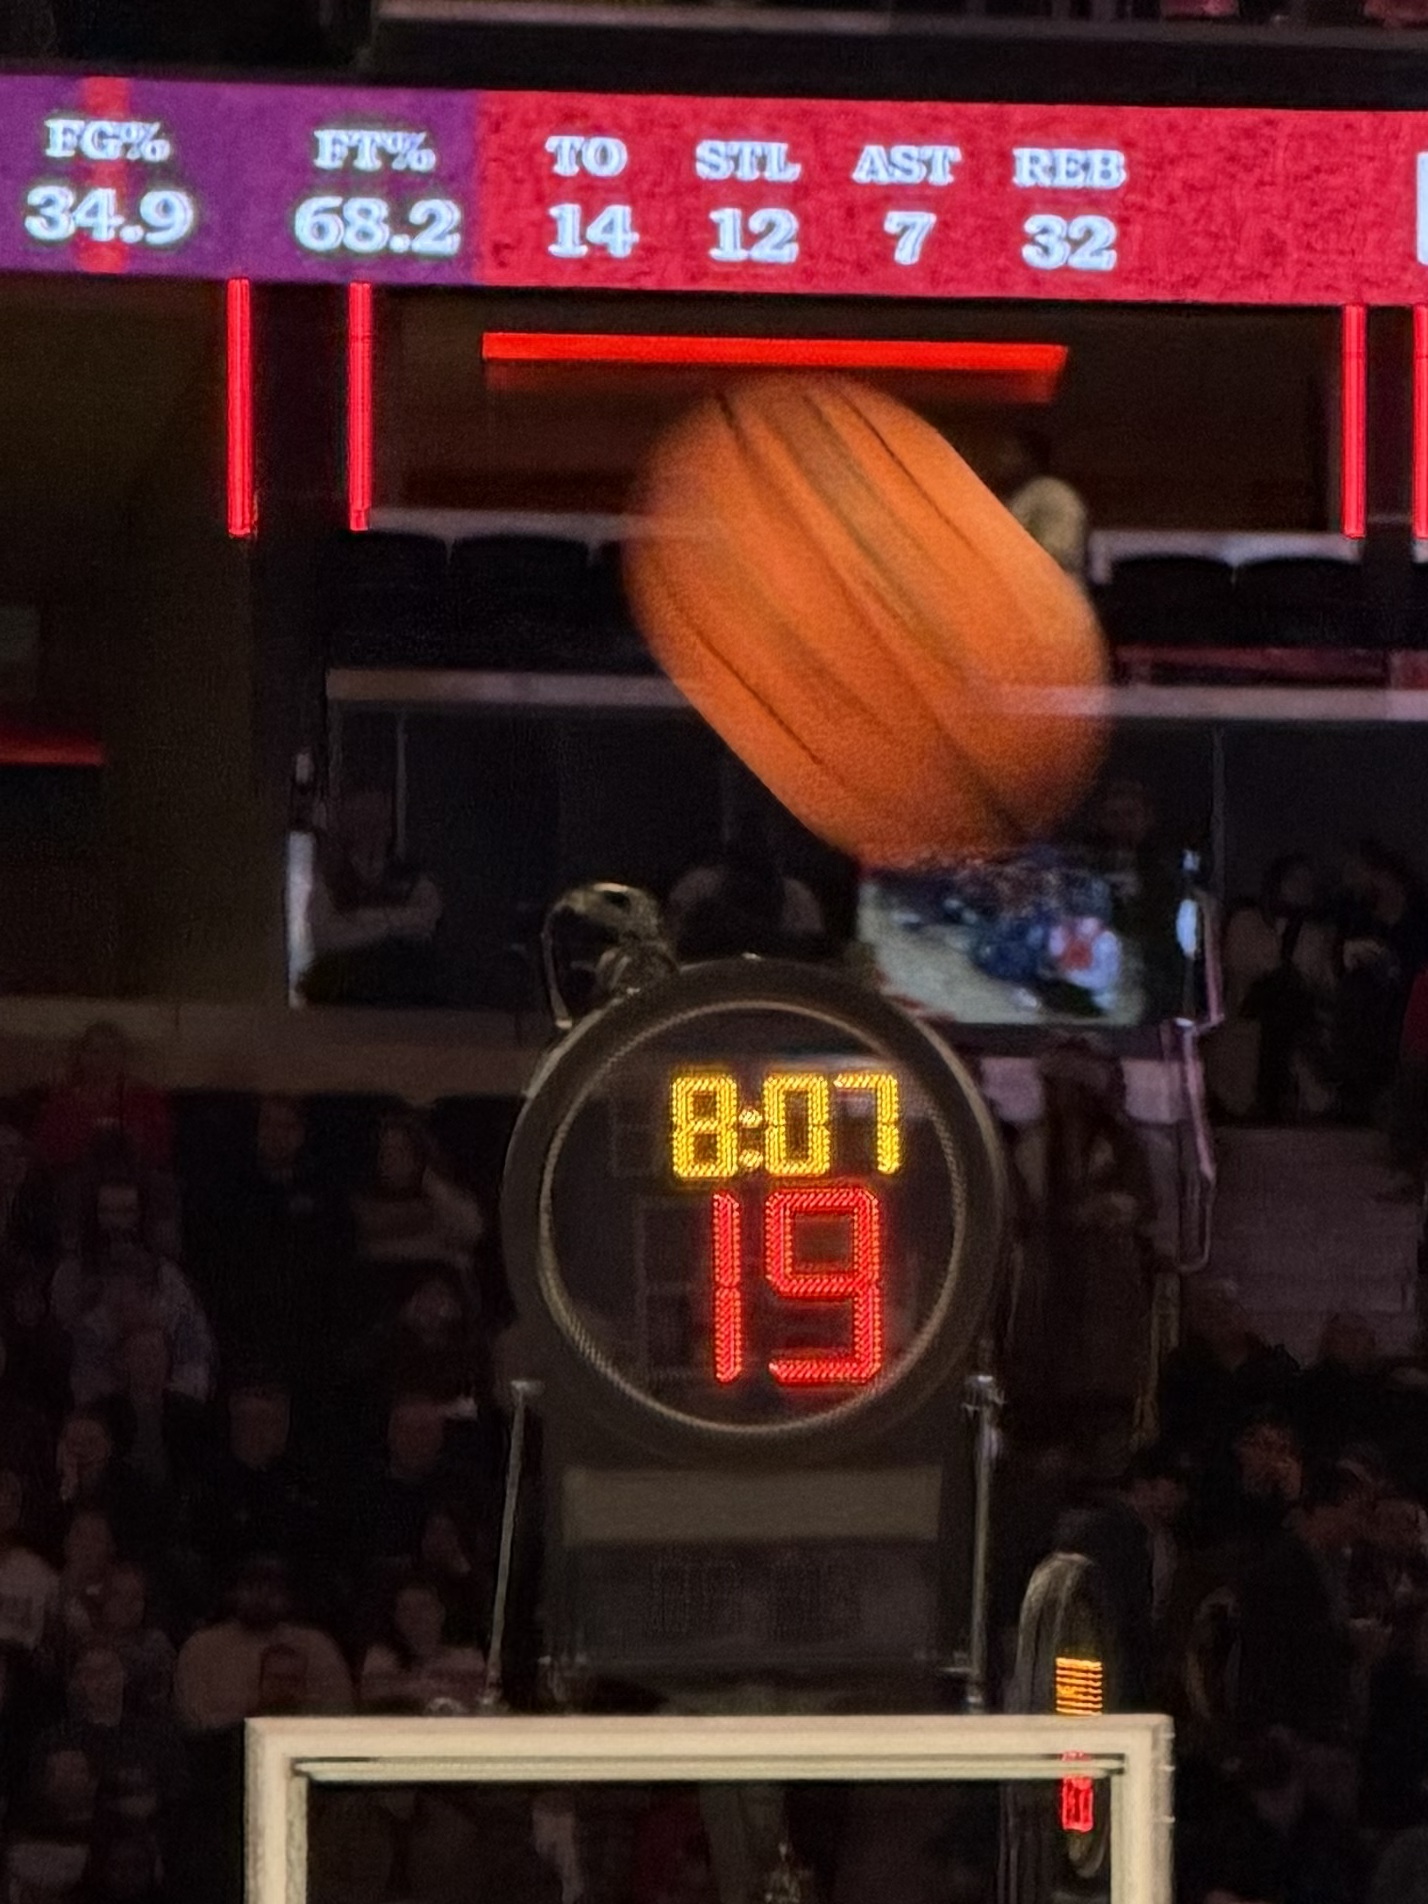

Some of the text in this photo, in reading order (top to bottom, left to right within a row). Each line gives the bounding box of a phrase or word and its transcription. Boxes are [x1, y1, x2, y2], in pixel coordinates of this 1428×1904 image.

[45, 117, 1126, 189] FG% FT% TO STL AST REB
[24, 186, 1117, 270] 34.9 68.2 14 12 7 32
[671, 1072, 900, 1179] 8:07
[712, 1189, 881, 1384] 19
